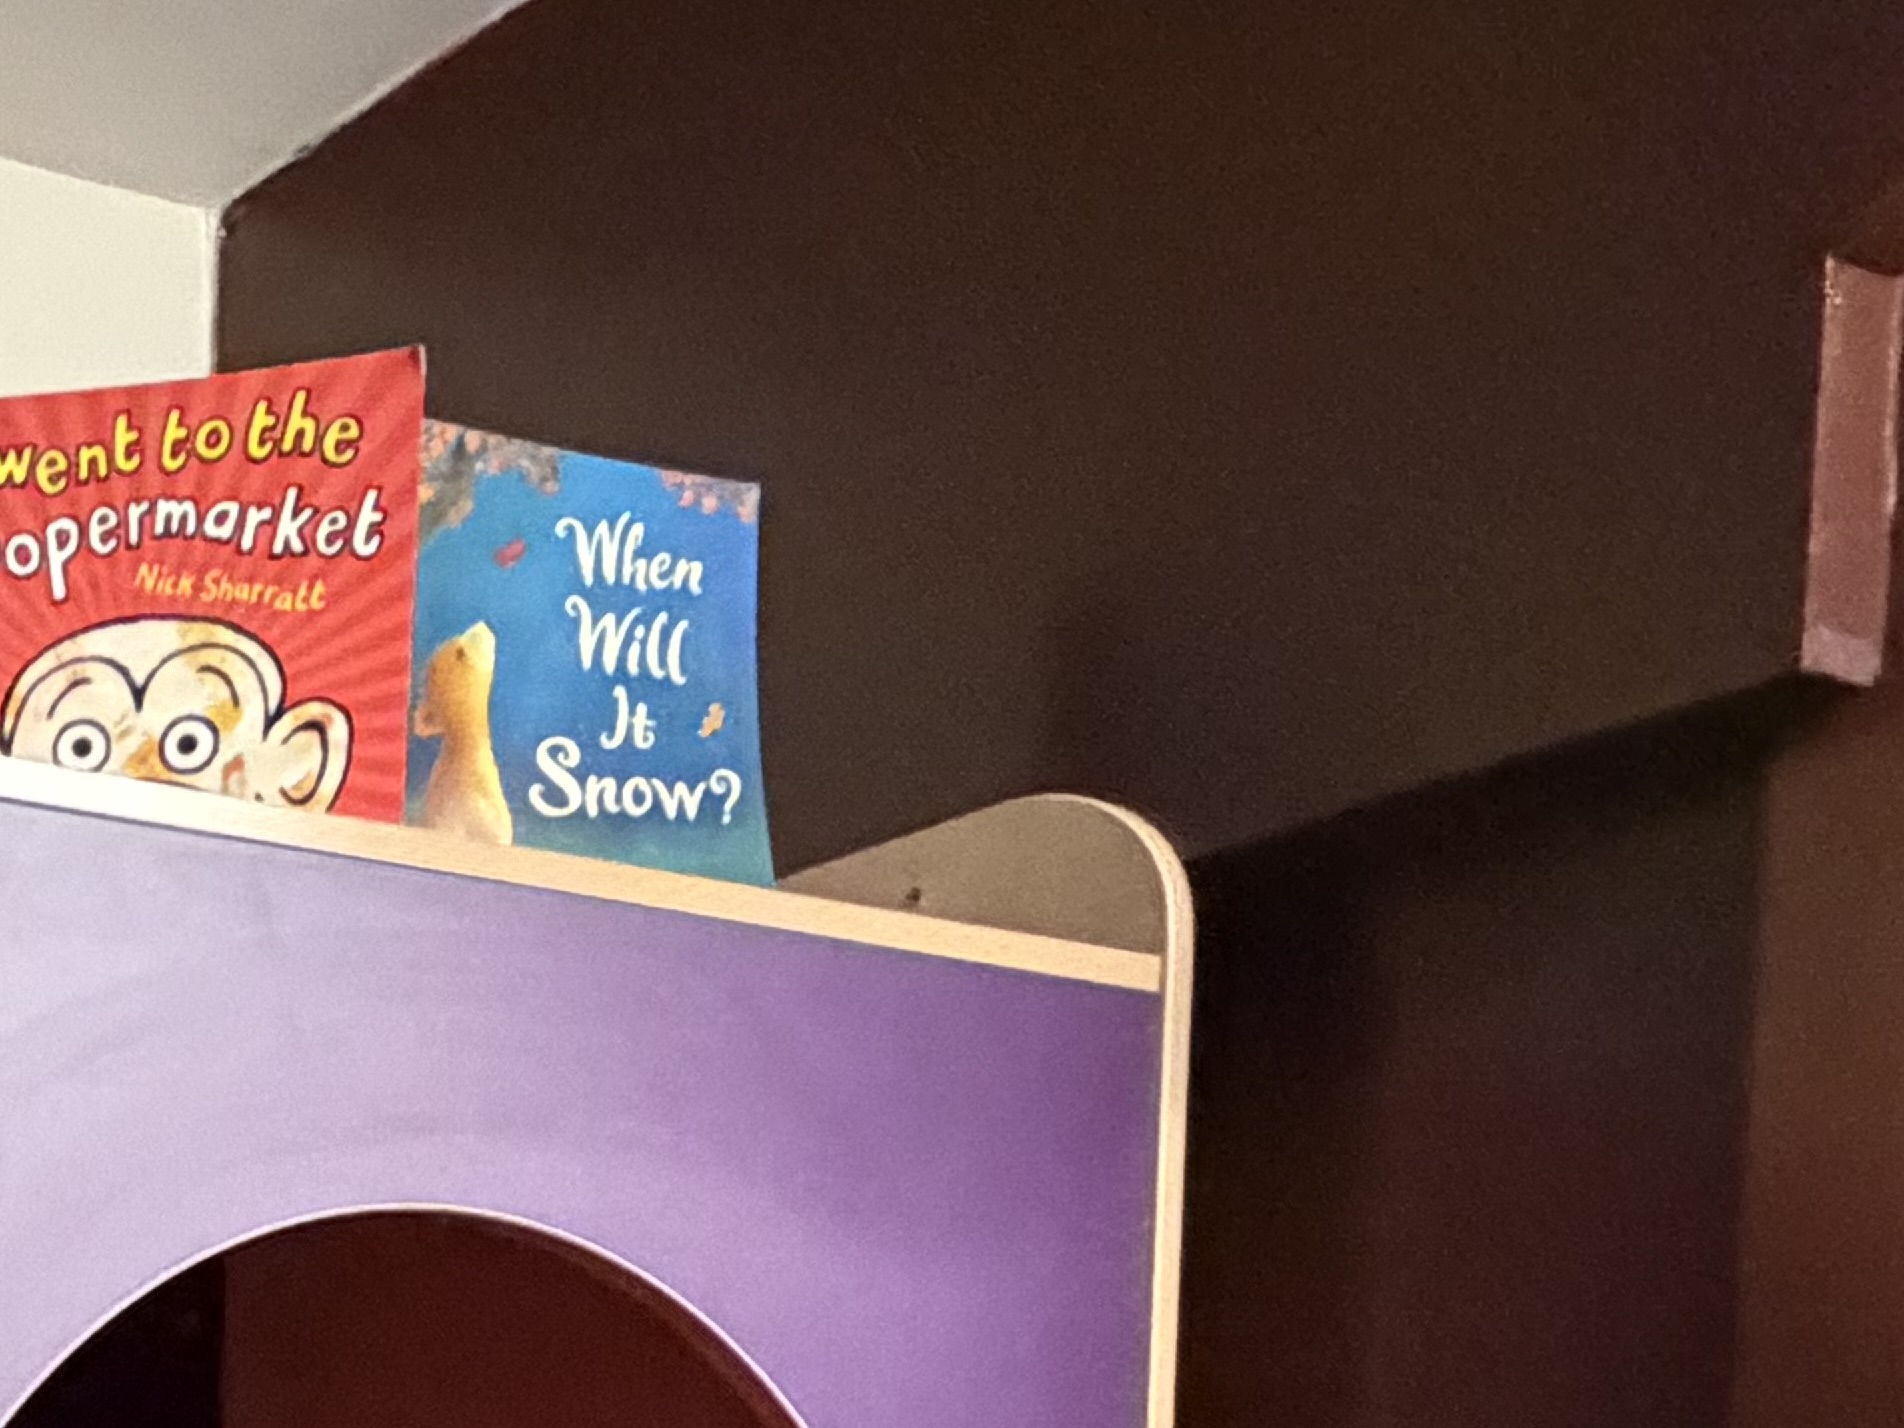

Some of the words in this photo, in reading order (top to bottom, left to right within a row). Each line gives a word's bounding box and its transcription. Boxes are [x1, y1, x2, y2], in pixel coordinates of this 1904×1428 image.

[160, 406, 231, 474] to
[244, 387, 363, 468] the
[133, 562, 193, 596] Nick
[199, 567, 327, 612] Sharratt
[554, 510, 704, 595] When
[564, 594, 689, 686] Will
[599, 684, 657, 750] It
[528, 735, 742, 825] Snow?
